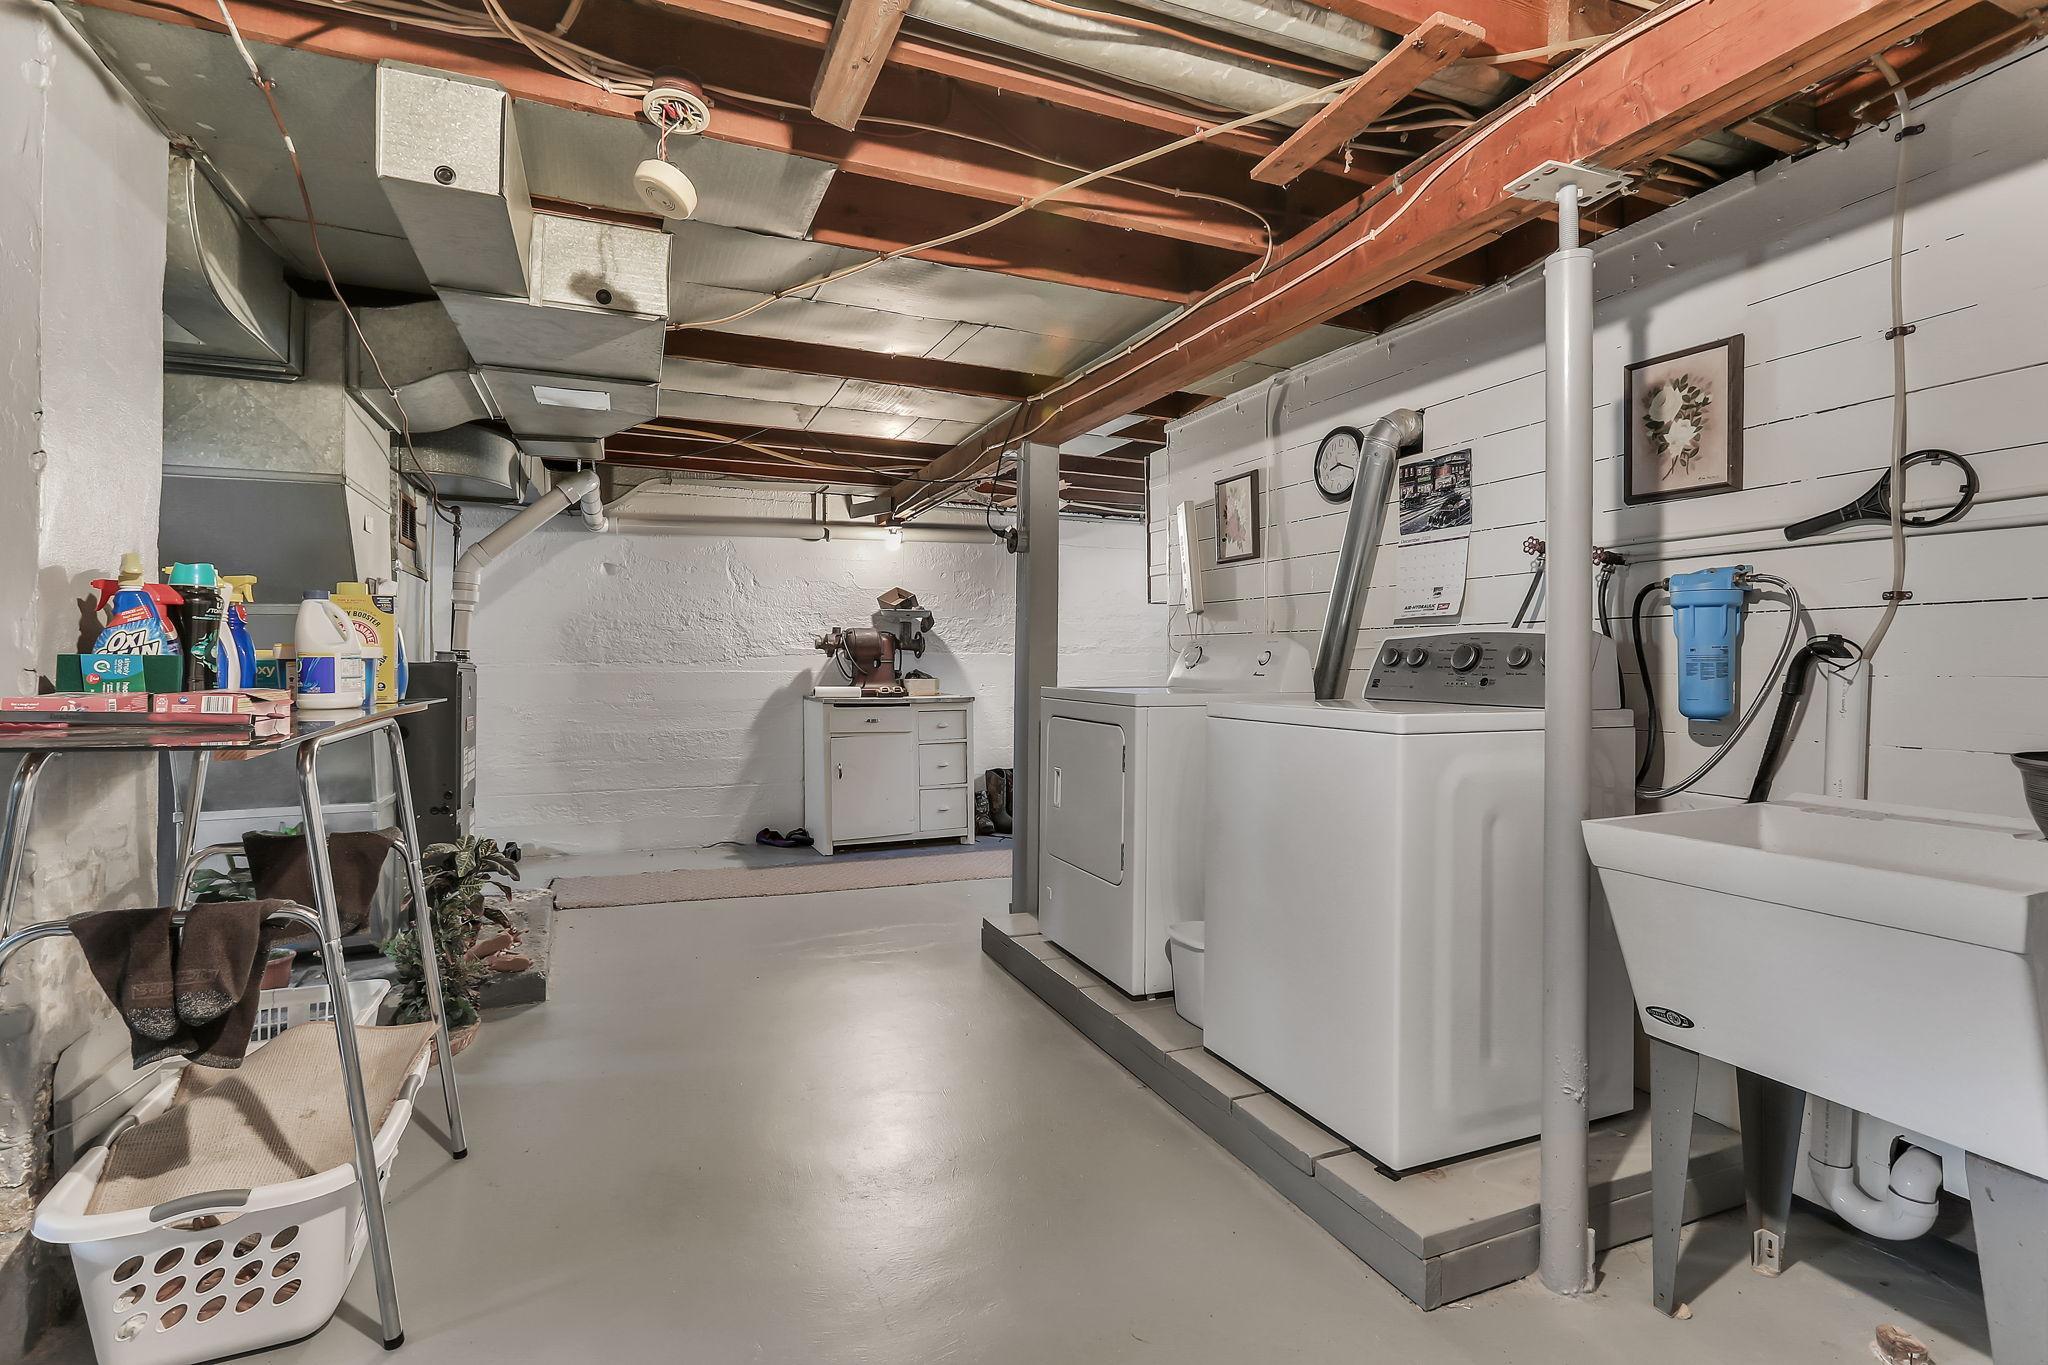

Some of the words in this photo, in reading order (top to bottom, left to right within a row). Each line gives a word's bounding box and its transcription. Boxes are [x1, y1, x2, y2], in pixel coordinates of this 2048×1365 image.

[352, 610, 381, 628] BOOSTER
[107, 630, 146, 651] OXI
[354, 622, 376, 645] AMME
